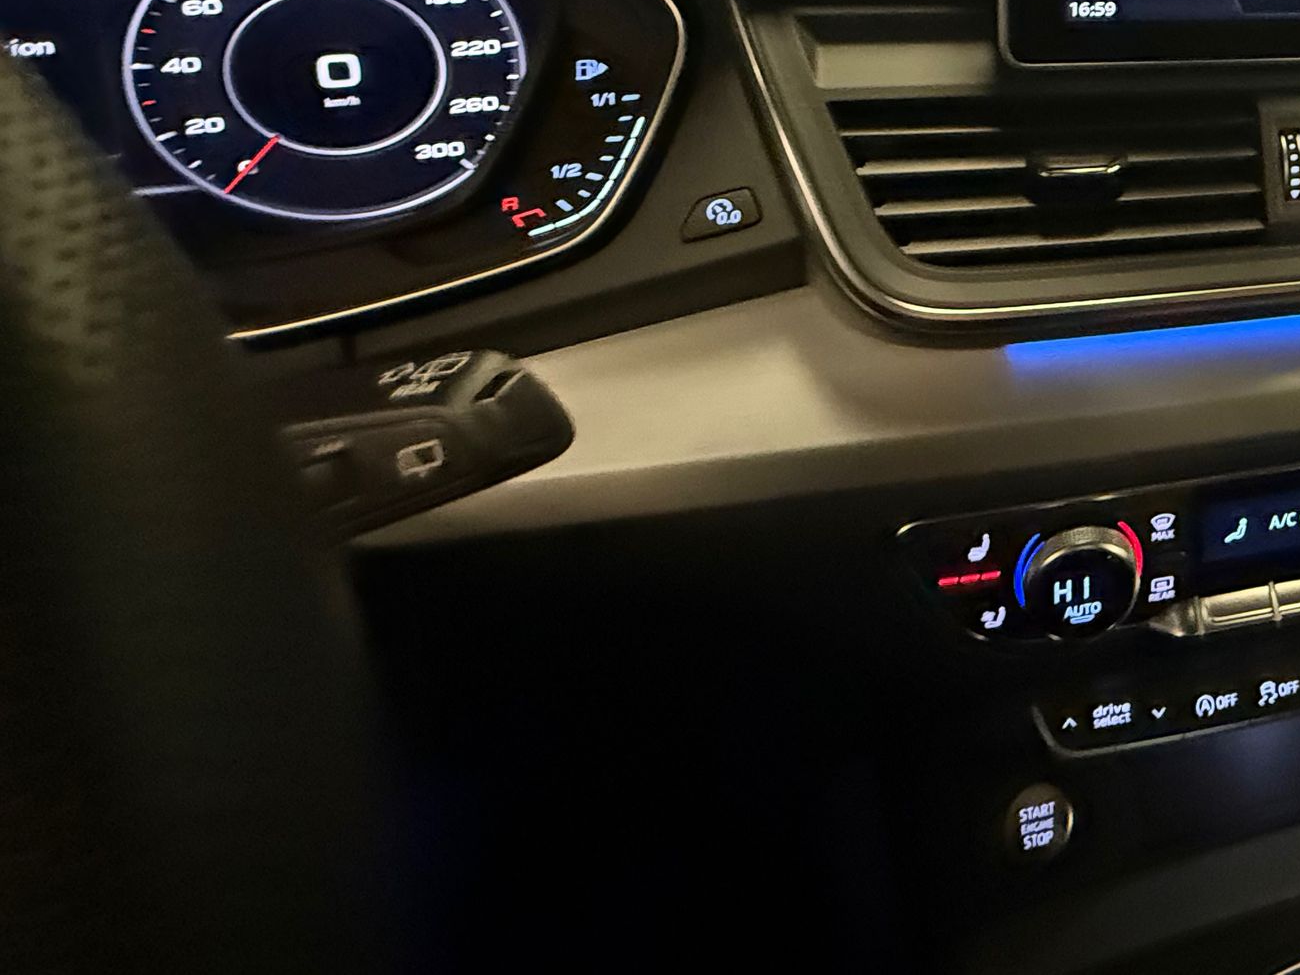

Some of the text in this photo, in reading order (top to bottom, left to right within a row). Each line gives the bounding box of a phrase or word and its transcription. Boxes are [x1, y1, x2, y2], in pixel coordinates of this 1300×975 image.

[1069, 1, 1117, 18] 16:59
[4, 38, 57, 57] ion
[450, 39, 501, 57] 220
[160, 56, 202, 74] 40
[316, 53, 362, 89] 0
[449, 96, 499, 114] 260
[590, 92, 616, 107] 1/1
[185, 117, 226, 135] 20
[414, 141, 466, 160] 300
[551, 162, 583, 178] 1/2
[1268, 511, 1297, 531] A/C
[1151, 529, 1176, 542] MAX
[1063, 601, 1103, 620] AUTO
[1277, 680, 1300, 698] OFF
[1092, 702, 1132, 719] drive
[1216, 692, 1239, 711] OFF
[1092, 712, 1132, 730] select
[1019, 801, 1055, 824] START
[1023, 830, 1055, 851] STOP
